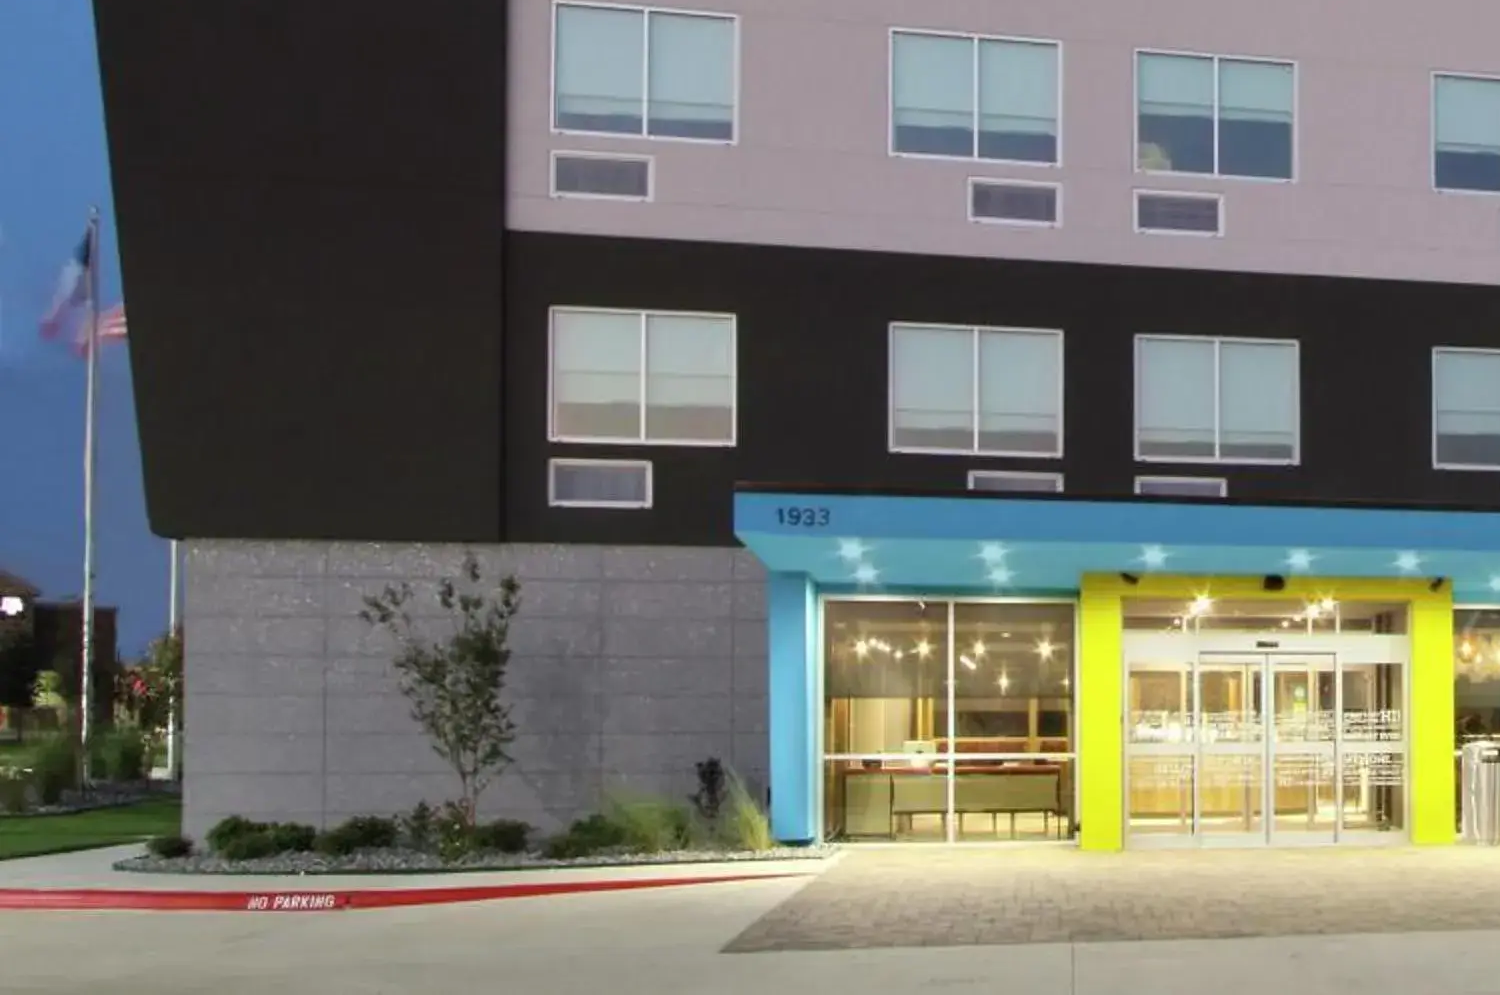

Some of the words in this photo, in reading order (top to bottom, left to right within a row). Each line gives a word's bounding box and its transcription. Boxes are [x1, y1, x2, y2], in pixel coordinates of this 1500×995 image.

[776, 506, 831, 527] 1933
[247, 894, 269, 909] NO
[272, 893, 335, 909] PARKING
